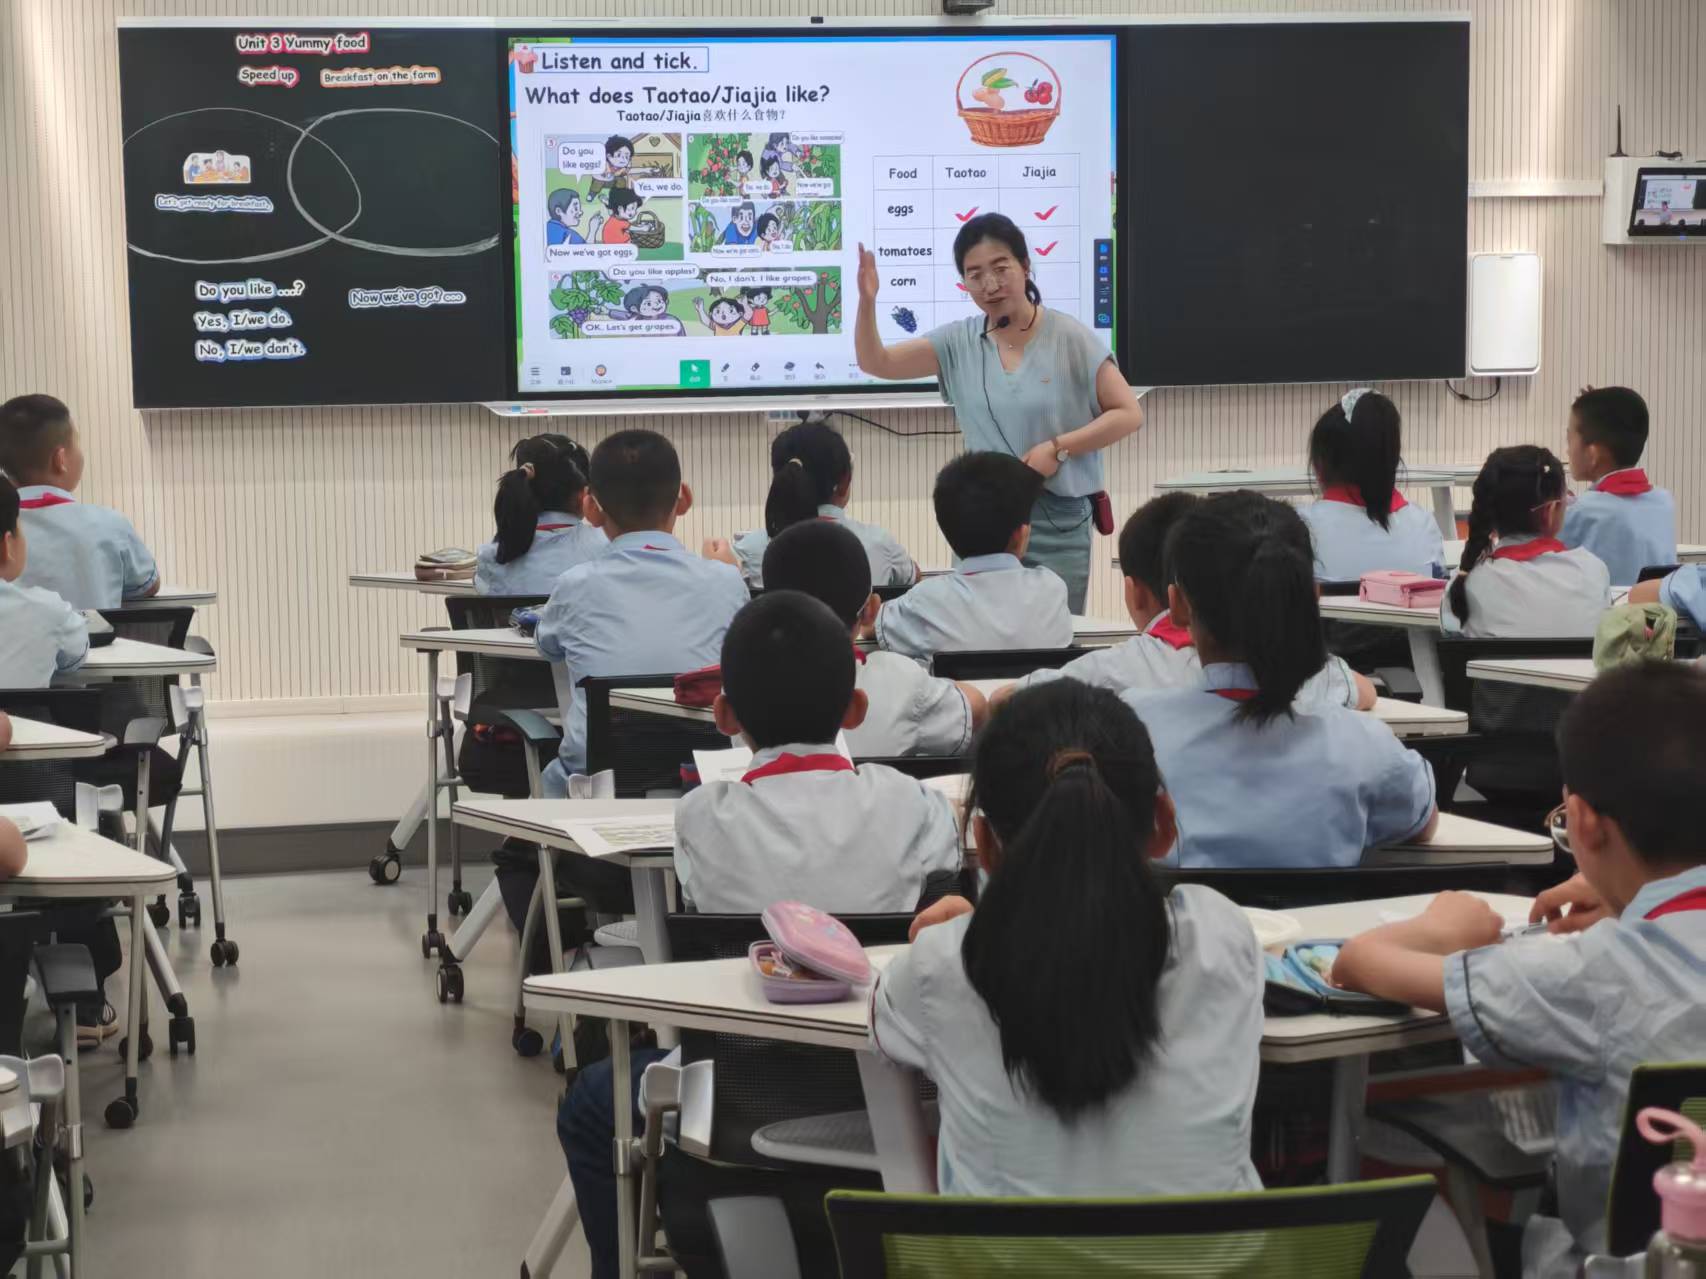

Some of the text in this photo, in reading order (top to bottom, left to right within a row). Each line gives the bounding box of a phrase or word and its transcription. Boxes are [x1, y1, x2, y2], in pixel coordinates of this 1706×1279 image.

[238, 35, 367, 53] Unit 3 Yummy food
[541, 50, 698, 70] Listen and tick.
[241, 68, 295, 83] Speed up
[324, 69, 437, 82] Breakfast on the farm
[525, 84, 831, 108] What does Taotao/Jiajia like?
[562, 146, 594, 158] Do you
[562, 160, 577, 169] like
[888, 165, 1057, 180] Food Taotao Jiajia
[639, 183, 654, 192] Yes,
[887, 204, 914, 217] eggs
[549, 248, 570, 257] Now
[573, 248, 595, 257] we've
[597, 249, 612, 259] got
[878, 245, 932, 257] tomatoes
[612, 267, 627, 276] Do
[629, 268, 645, 278] you
[648, 267, 662, 276] like
[765, 274, 780, 282] like
[890, 276, 917, 287] corn
[199, 284, 216, 297] Do
[221, 286, 245, 300] you
[248, 282, 272, 296] like
[351, 291, 378, 304] Now
[382, 290, 416, 303] we've
[419, 290, 441, 305] got
[198, 312, 291, 330] Yes, I/we do.
[606, 323, 627, 332] Let's
[630, 324, 643, 333] get
[199, 341, 305, 358] No, I/we don't.
